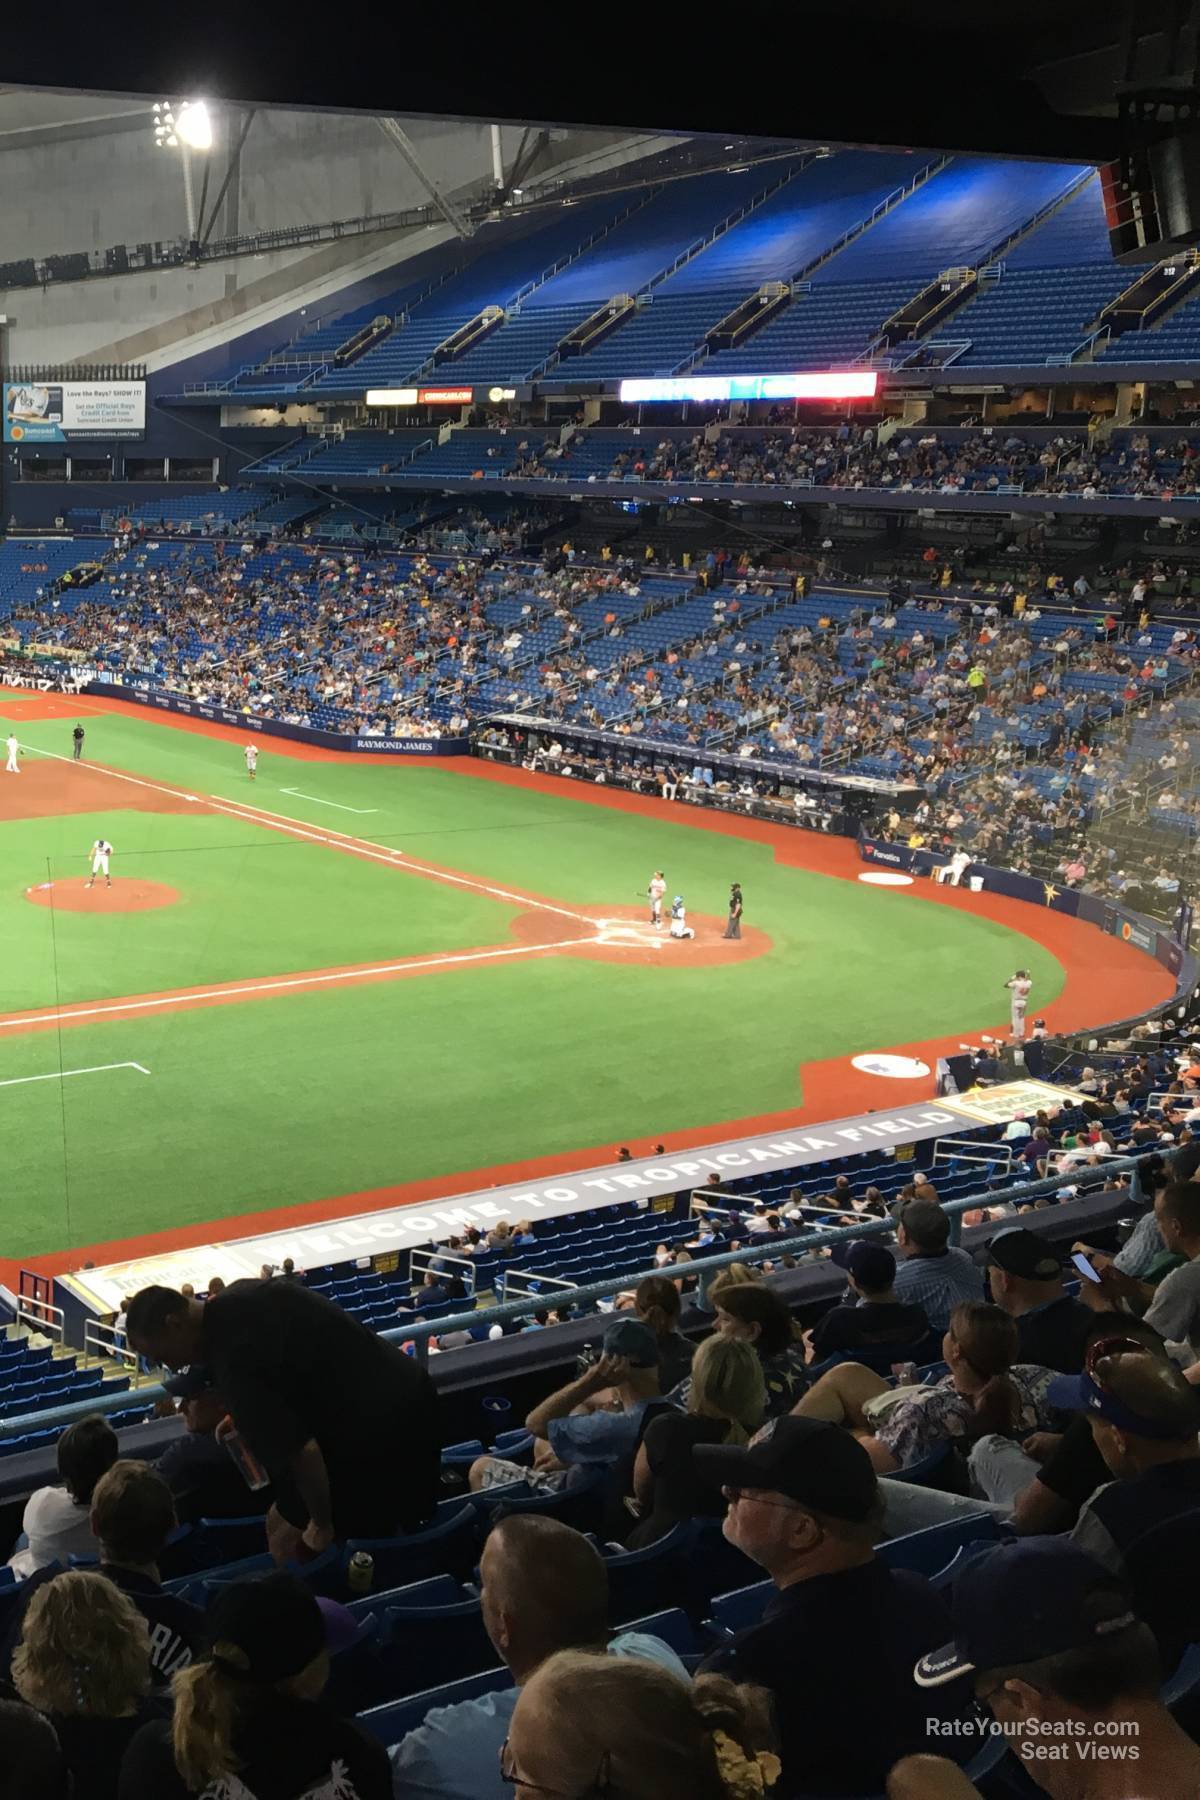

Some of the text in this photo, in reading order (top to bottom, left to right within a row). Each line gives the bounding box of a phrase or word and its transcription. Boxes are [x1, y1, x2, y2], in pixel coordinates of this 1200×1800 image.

[357, 739, 433, 751] RAYMOND JAMES
[255, 1110, 956, 1265] WELCOME TO TROPICANA FIELD
